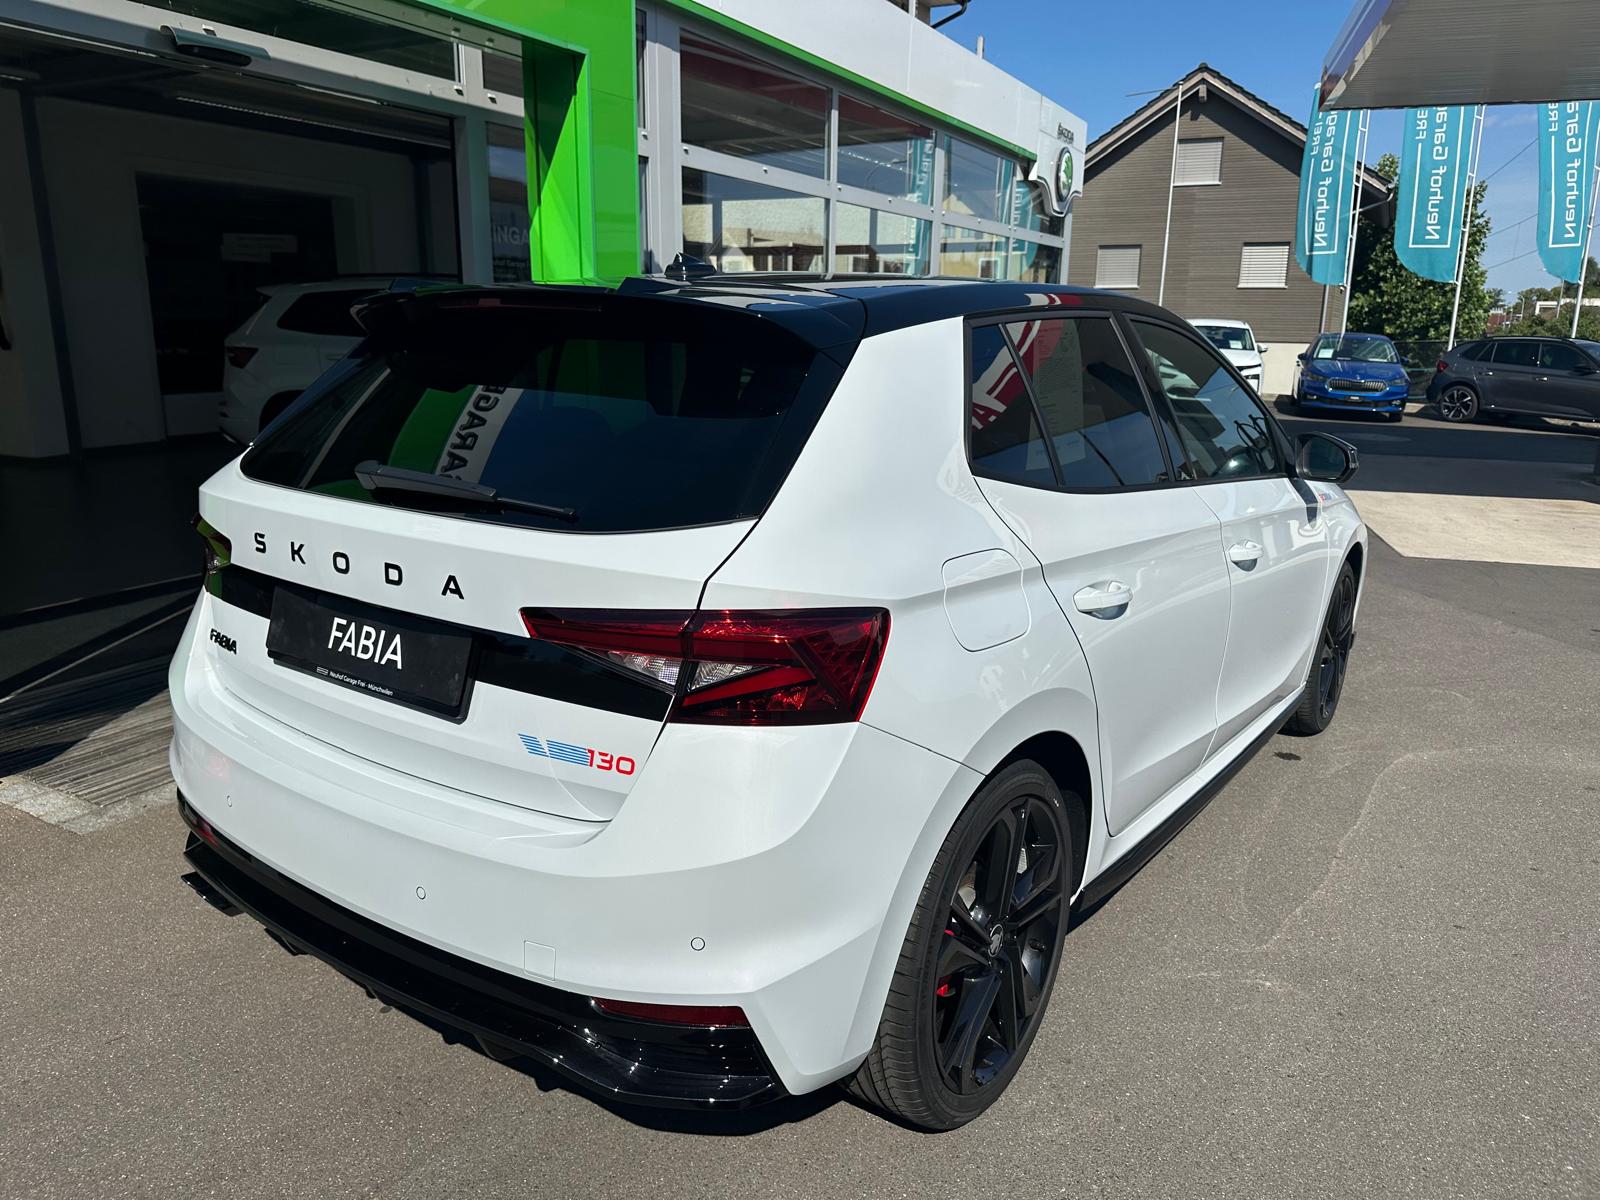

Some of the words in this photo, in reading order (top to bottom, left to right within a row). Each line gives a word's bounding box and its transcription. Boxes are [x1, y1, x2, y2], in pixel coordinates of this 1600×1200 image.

[254, 532, 465, 600] SKODA
[210, 628, 237, 655] FABIA
[327, 616, 402, 670] FABIA
[329, 671, 344, 680] Neuhof
[344, 675, 358, 685] Garage
[587, 748, 636, 775] 130
